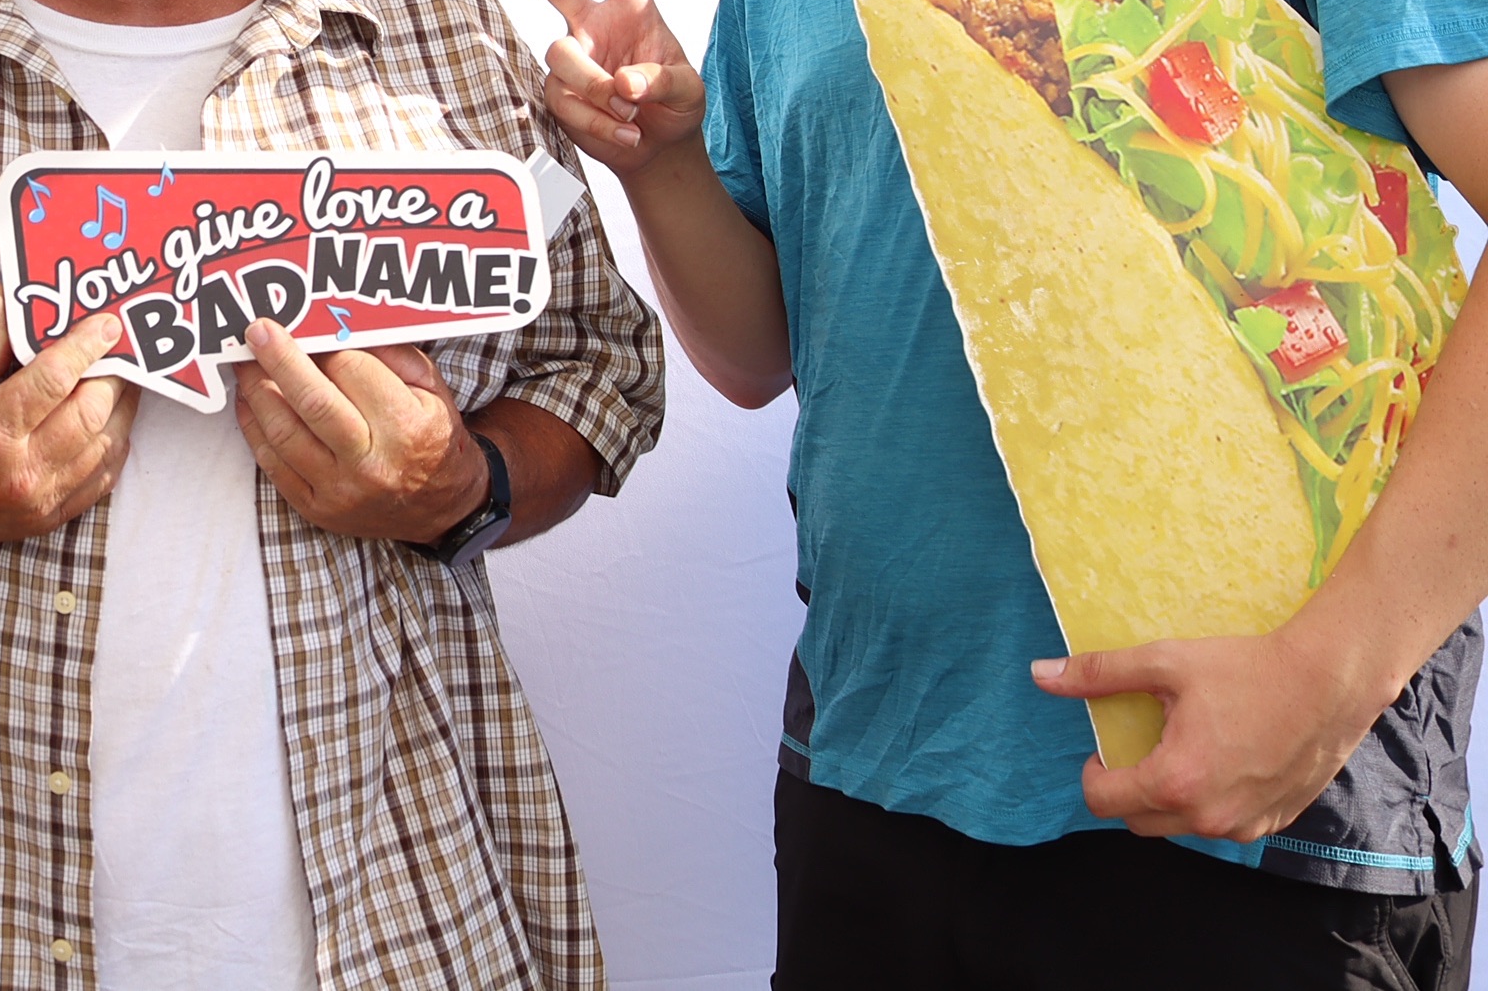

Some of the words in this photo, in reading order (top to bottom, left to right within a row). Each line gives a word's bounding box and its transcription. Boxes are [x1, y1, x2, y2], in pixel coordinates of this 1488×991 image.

[17, 252, 154, 338] You
[163, 201, 294, 299] give
[302, 157, 438, 231] love
[448, 188, 495, 230] a
[126, 268, 307, 374] BAD
[312, 236, 539, 315] NAME!
